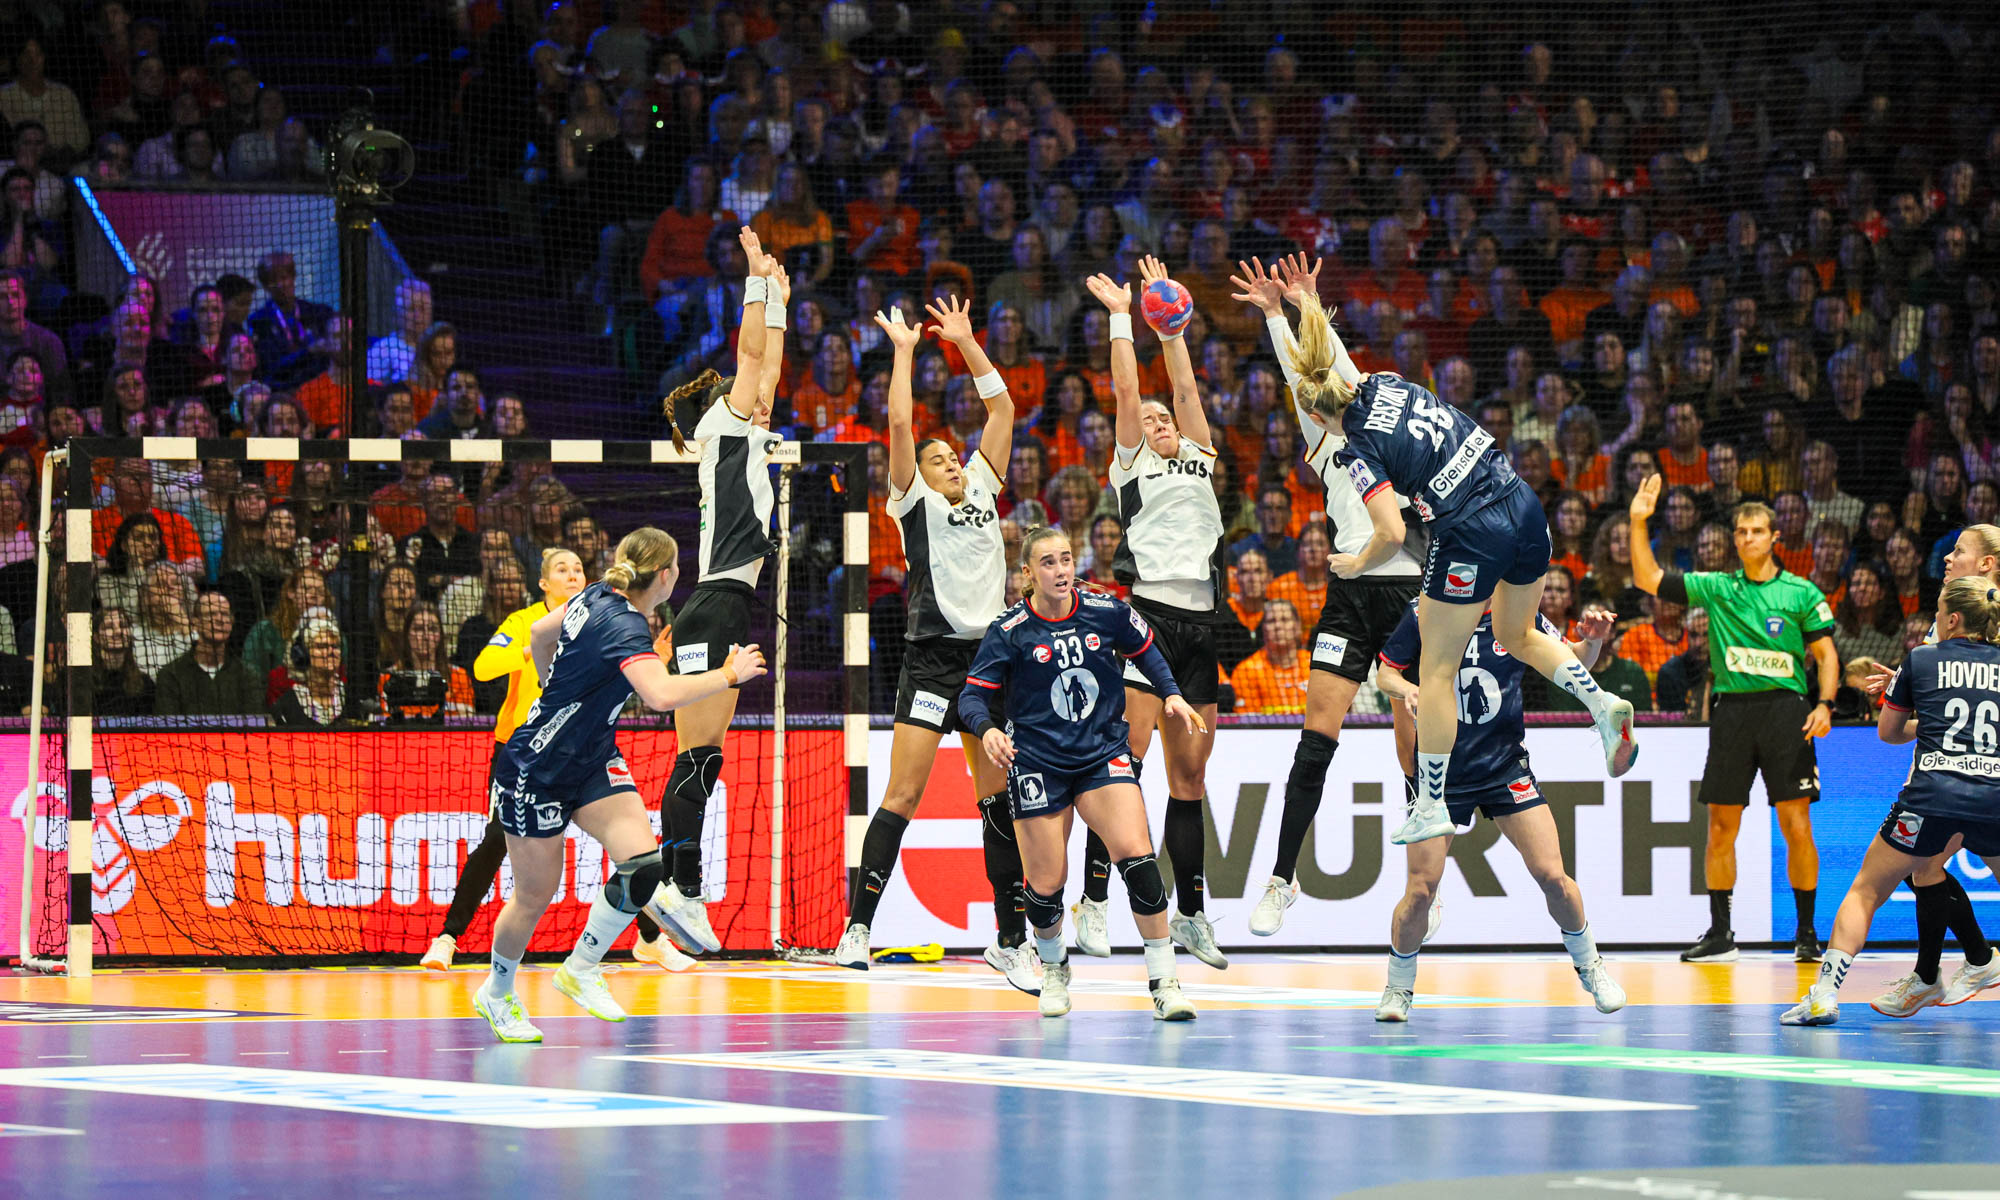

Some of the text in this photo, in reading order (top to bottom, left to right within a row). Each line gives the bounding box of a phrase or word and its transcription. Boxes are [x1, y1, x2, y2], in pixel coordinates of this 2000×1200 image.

[1407, 399, 1454, 453] 25
[678, 651, 706, 662] brother
[1054, 636, 1084, 669] 33
[1746, 655, 1789, 670] DEKRA
[915, 698, 946, 713] brother
[1942, 698, 2000, 755] 26
[525, 793, 536, 804] 15
